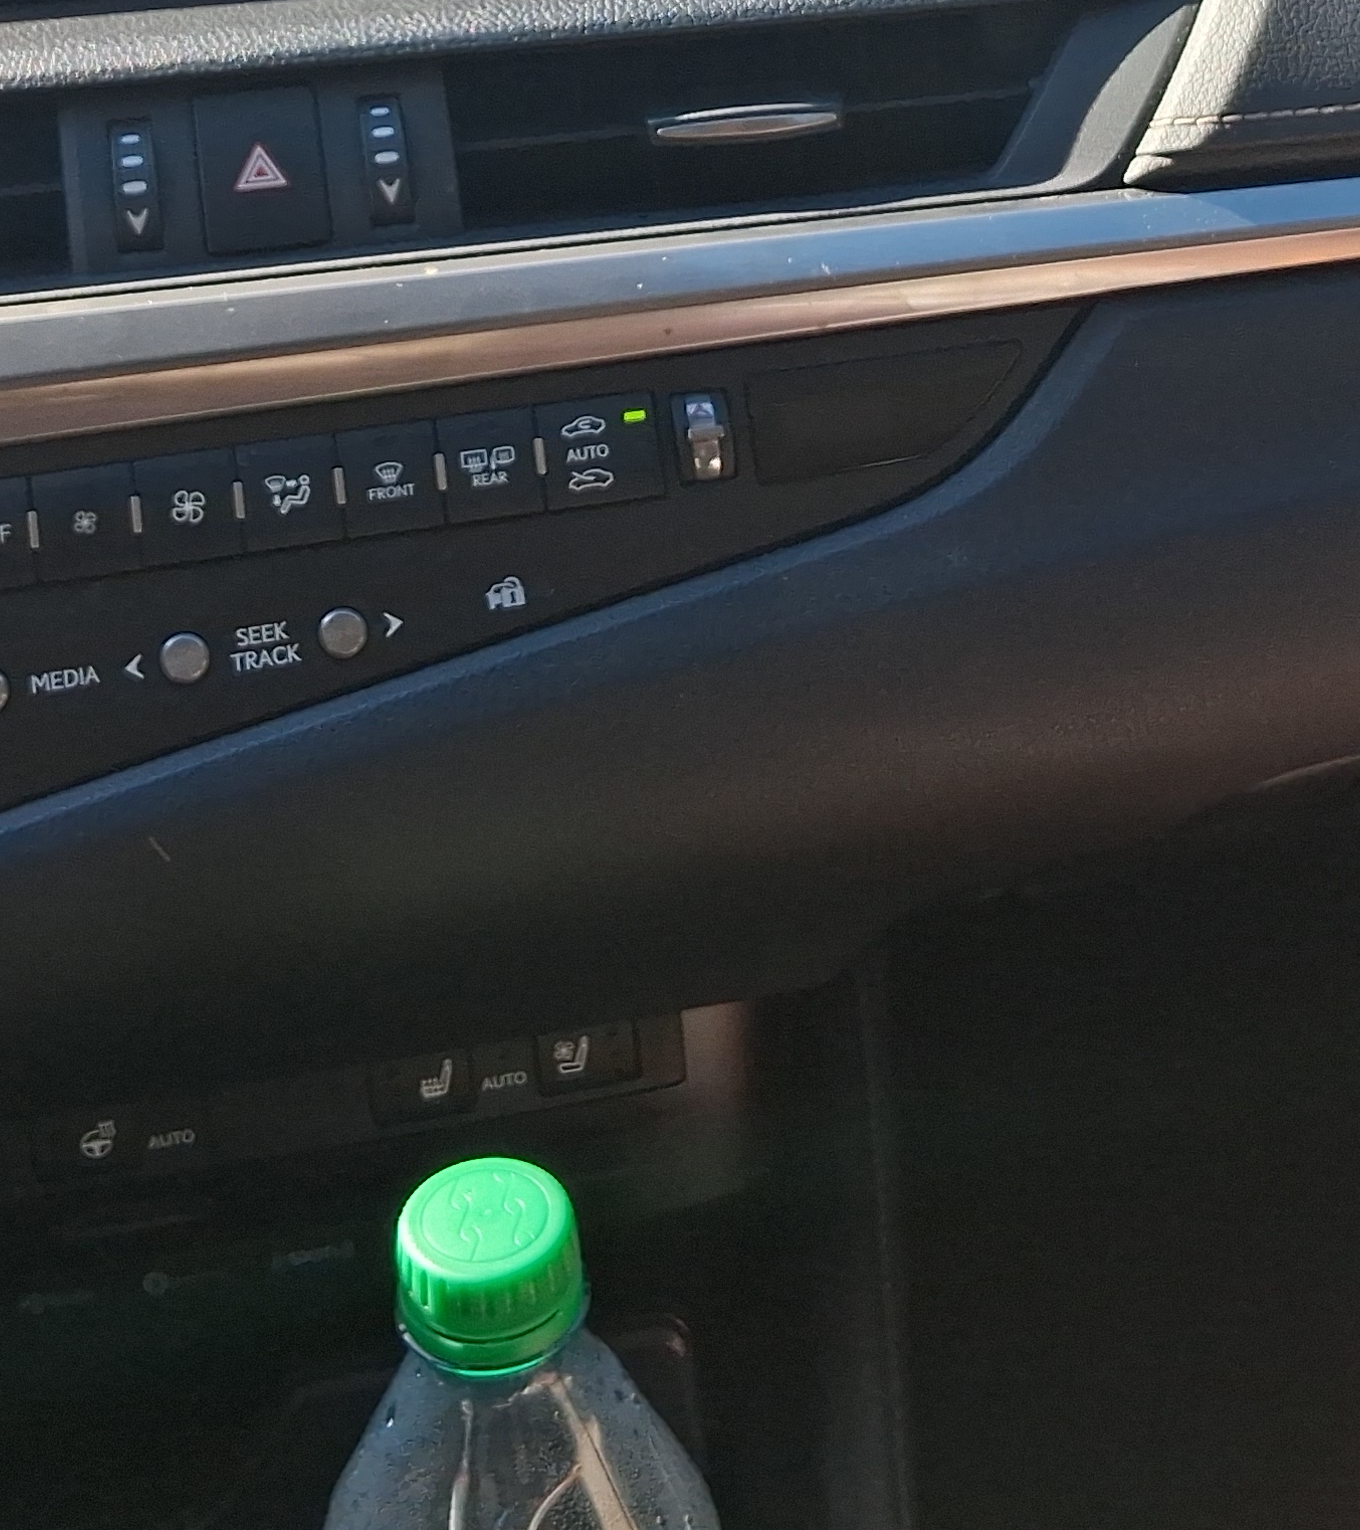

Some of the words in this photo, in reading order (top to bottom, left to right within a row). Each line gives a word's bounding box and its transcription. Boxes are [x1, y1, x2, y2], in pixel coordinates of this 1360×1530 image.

[566, 444, 609, 464] AUTO
[472, 471, 510, 487] REAR
[368, 483, 416, 501] FRONT
[236, 621, 289, 646] SEEK
[230, 643, 303, 671] TRACK
[31, 666, 101, 695] MEDIA
[481, 1071, 528, 1092] AUTO
[147, 1128, 196, 1150] AUTO
